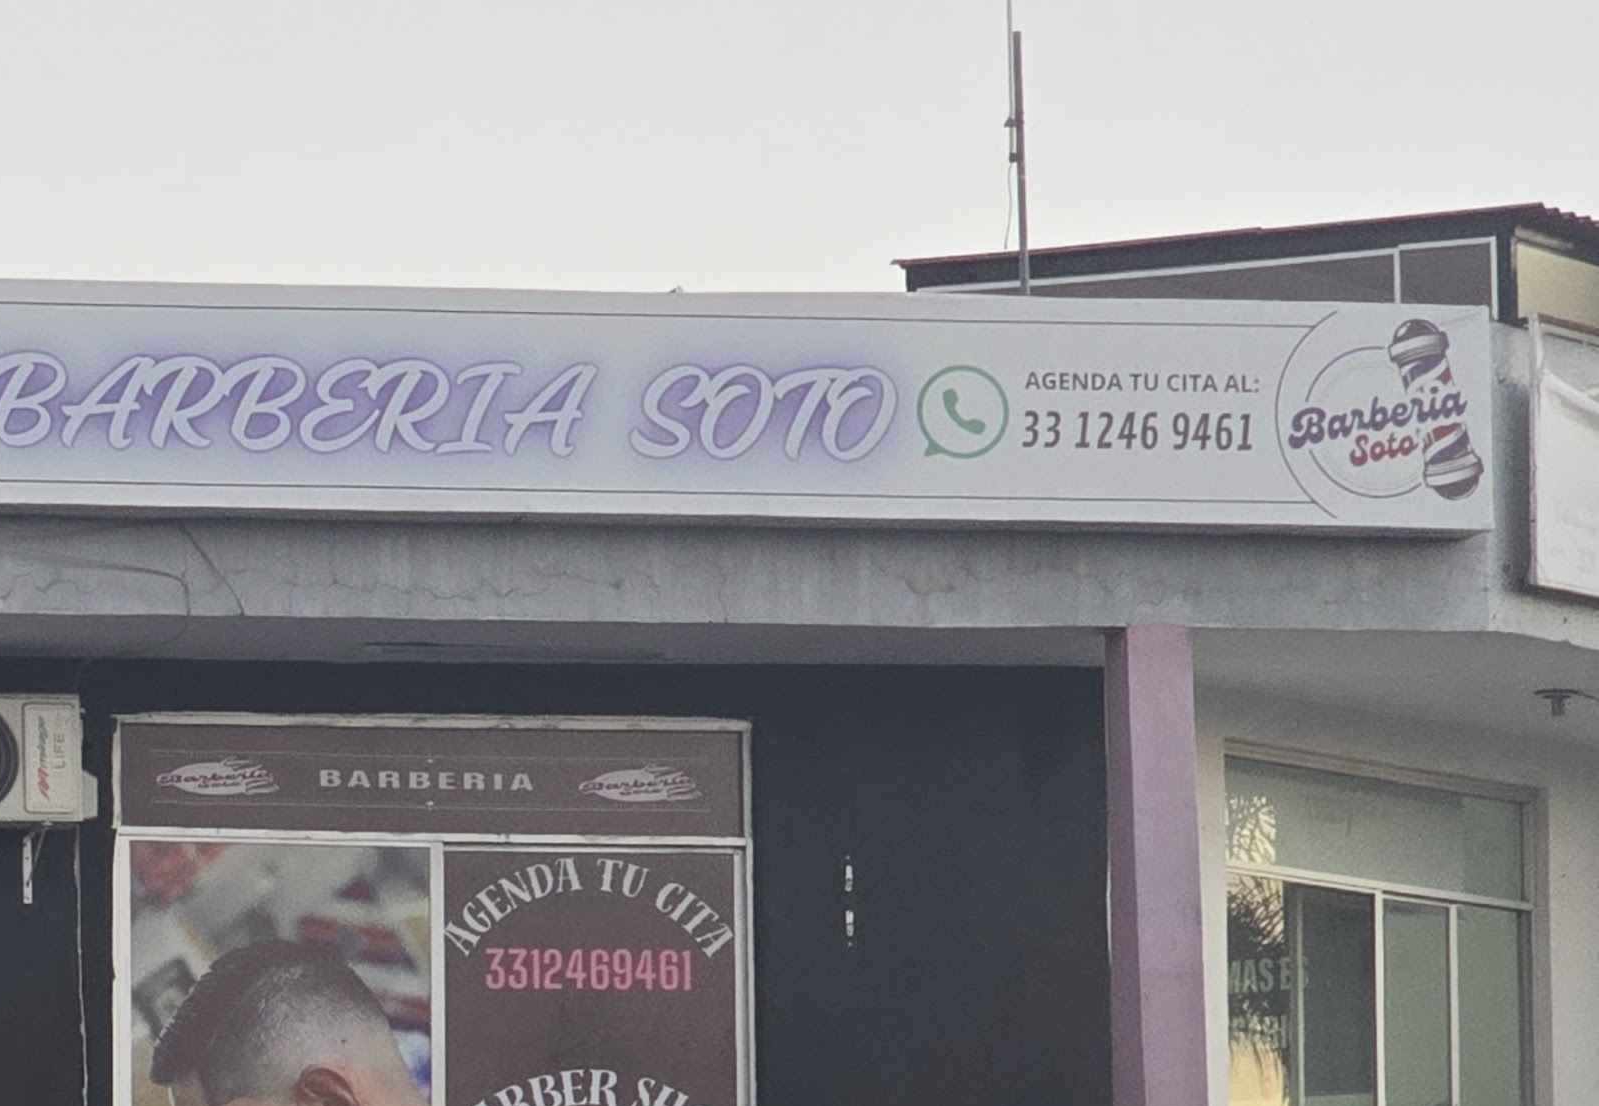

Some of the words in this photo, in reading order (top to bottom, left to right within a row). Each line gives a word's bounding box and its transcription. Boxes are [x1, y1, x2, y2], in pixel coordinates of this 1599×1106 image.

[1024, 371, 1123, 391] AGENDA
[1129, 373, 1159, 392] TU
[1166, 374, 1218, 393] CITA
[1223, 374, 1260, 393] AL:
[630, 363, 899, 463] SOTO
[1021, 410, 1061, 449] 33
[1074, 411, 1159, 450] 1246
[1172, 412, 1253, 451] 9461
[1288, 386, 1468, 449] Barberia
[1349, 431, 1419, 468] Soto
[319, 768, 535, 791] BARBERIA
[443, 857, 583, 957] AGENDA
[597, 858, 650, 899] TU
[655, 882, 735, 958] CITA
[485, 948, 692, 991] 3312469461
